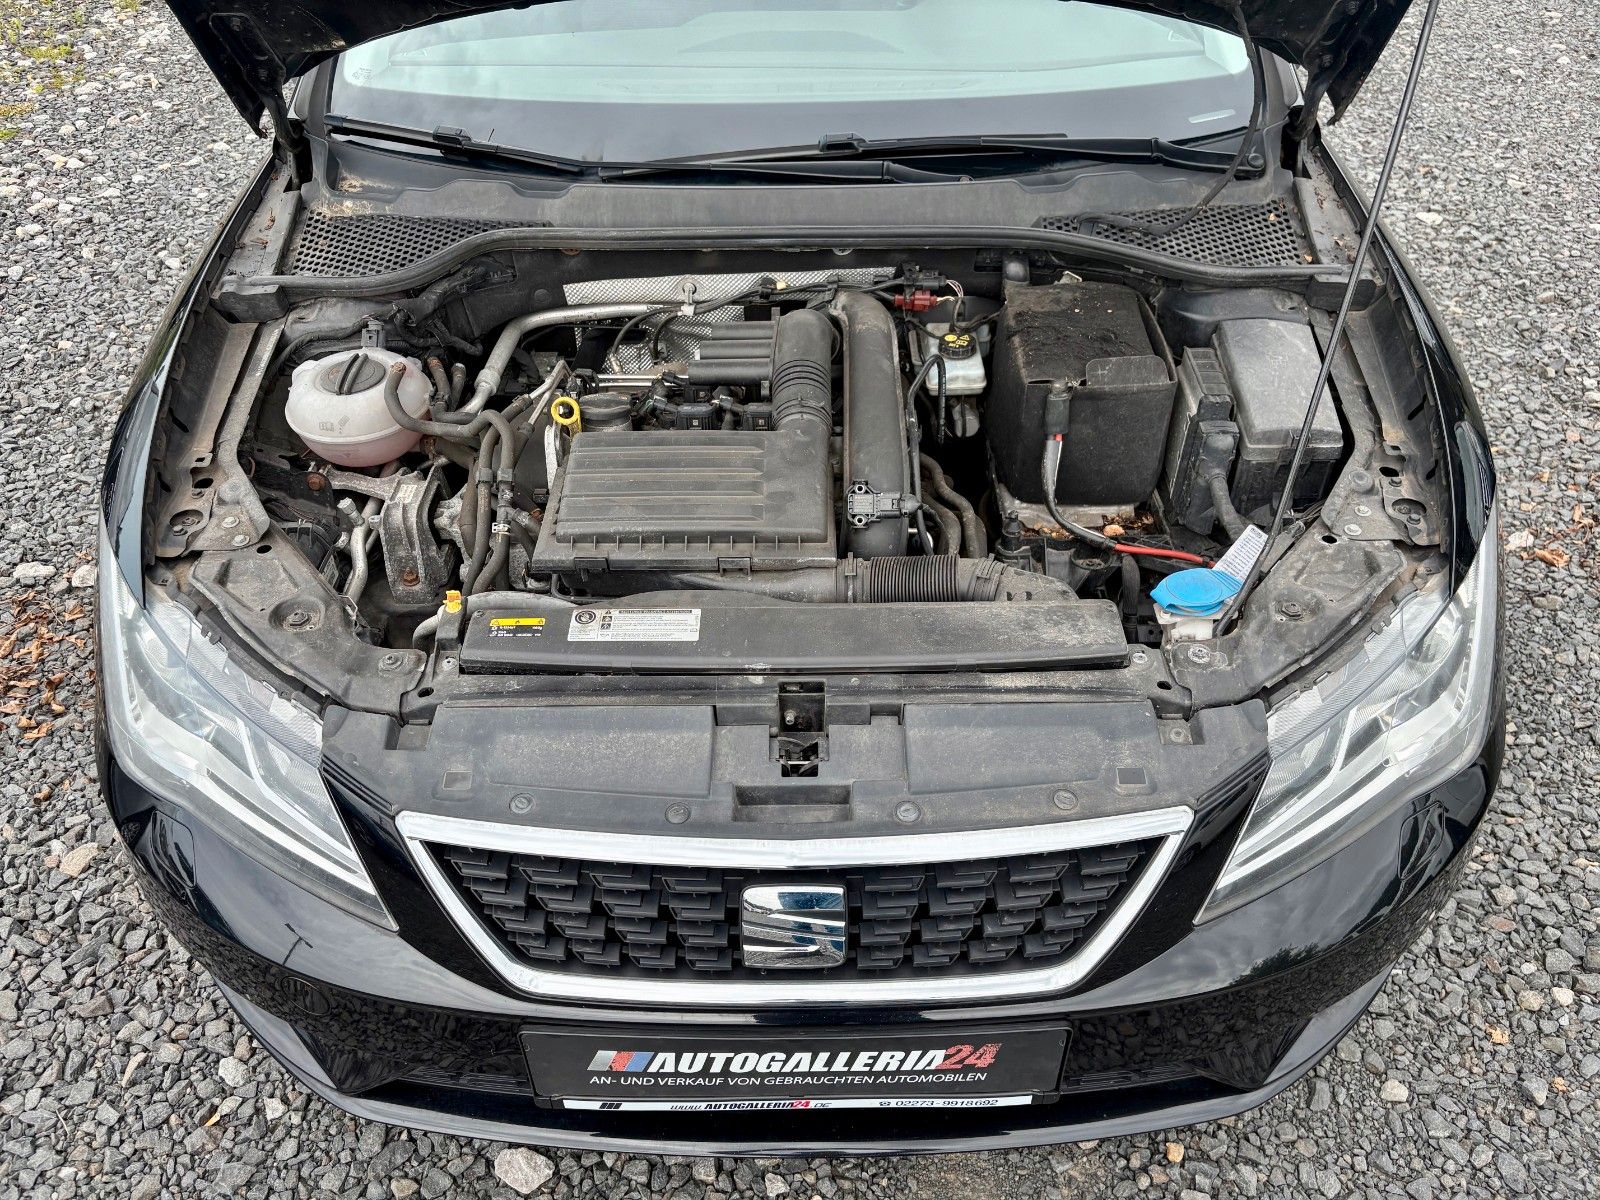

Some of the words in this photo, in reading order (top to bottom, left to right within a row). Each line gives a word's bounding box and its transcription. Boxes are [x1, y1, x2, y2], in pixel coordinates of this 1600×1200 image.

[590, 1076, 617, 1085] AN-
[620, 1077, 654, 1086] UND
[657, 1077, 724, 1086] VERKAUF
[728, 1077, 761, 1086] VON
[764, 1076, 873, 1086] GEBRAUCHTEN
[875, 1073, 987, 1084] AUTOMOBILEN
